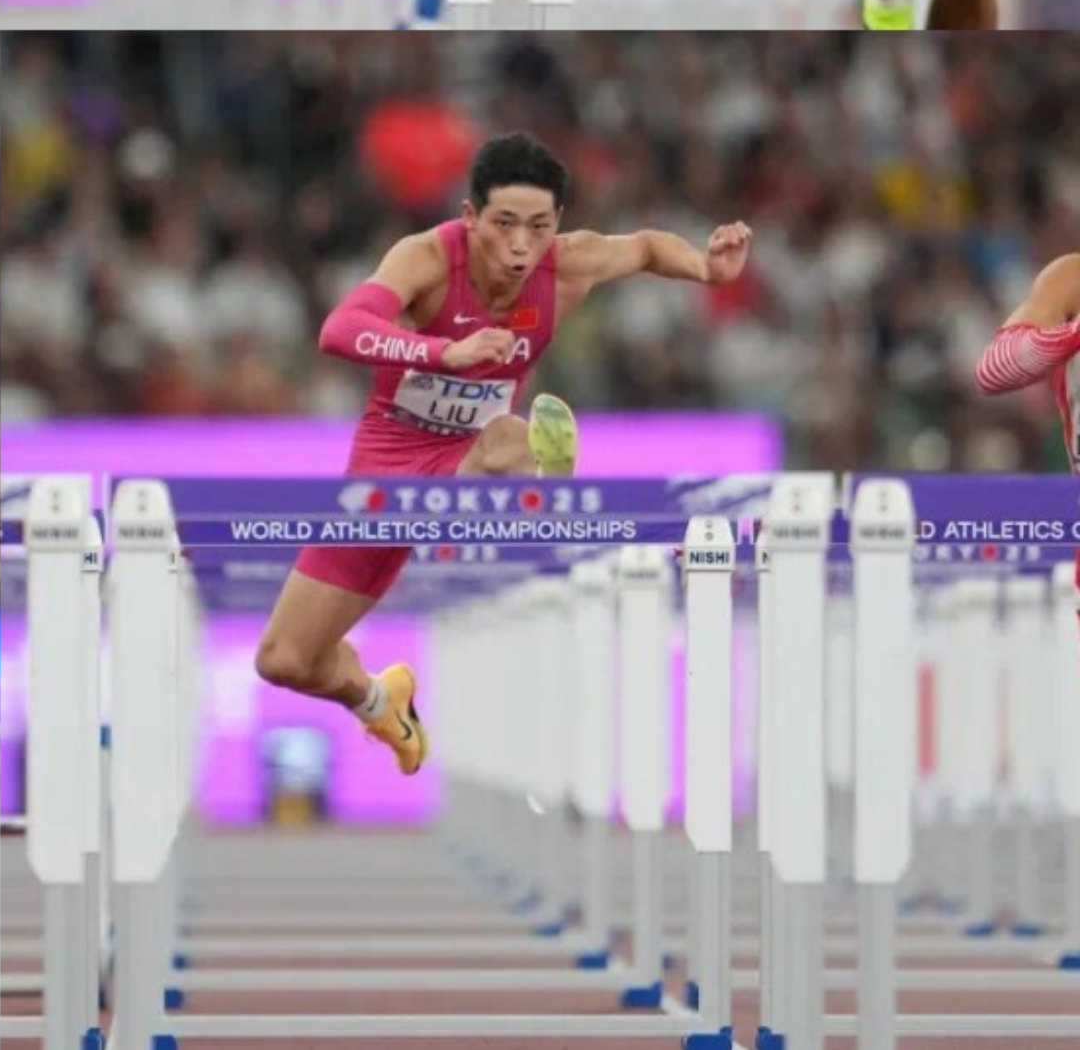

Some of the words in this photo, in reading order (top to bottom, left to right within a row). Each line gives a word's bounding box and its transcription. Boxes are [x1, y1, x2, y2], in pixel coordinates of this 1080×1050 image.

[355, 332, 429, 363] CHINA
[440, 377, 503, 401] TDK
[429, 400, 478, 425] LIU
[231, 522, 312, 539] WORLD
[320, 521, 441, 539] ATHLETICS
[448, 520, 637, 539] CHAMPIONSHIPS
[944, 521, 1065, 540] ATHLETICS
[690, 551, 730, 564] NISHI
